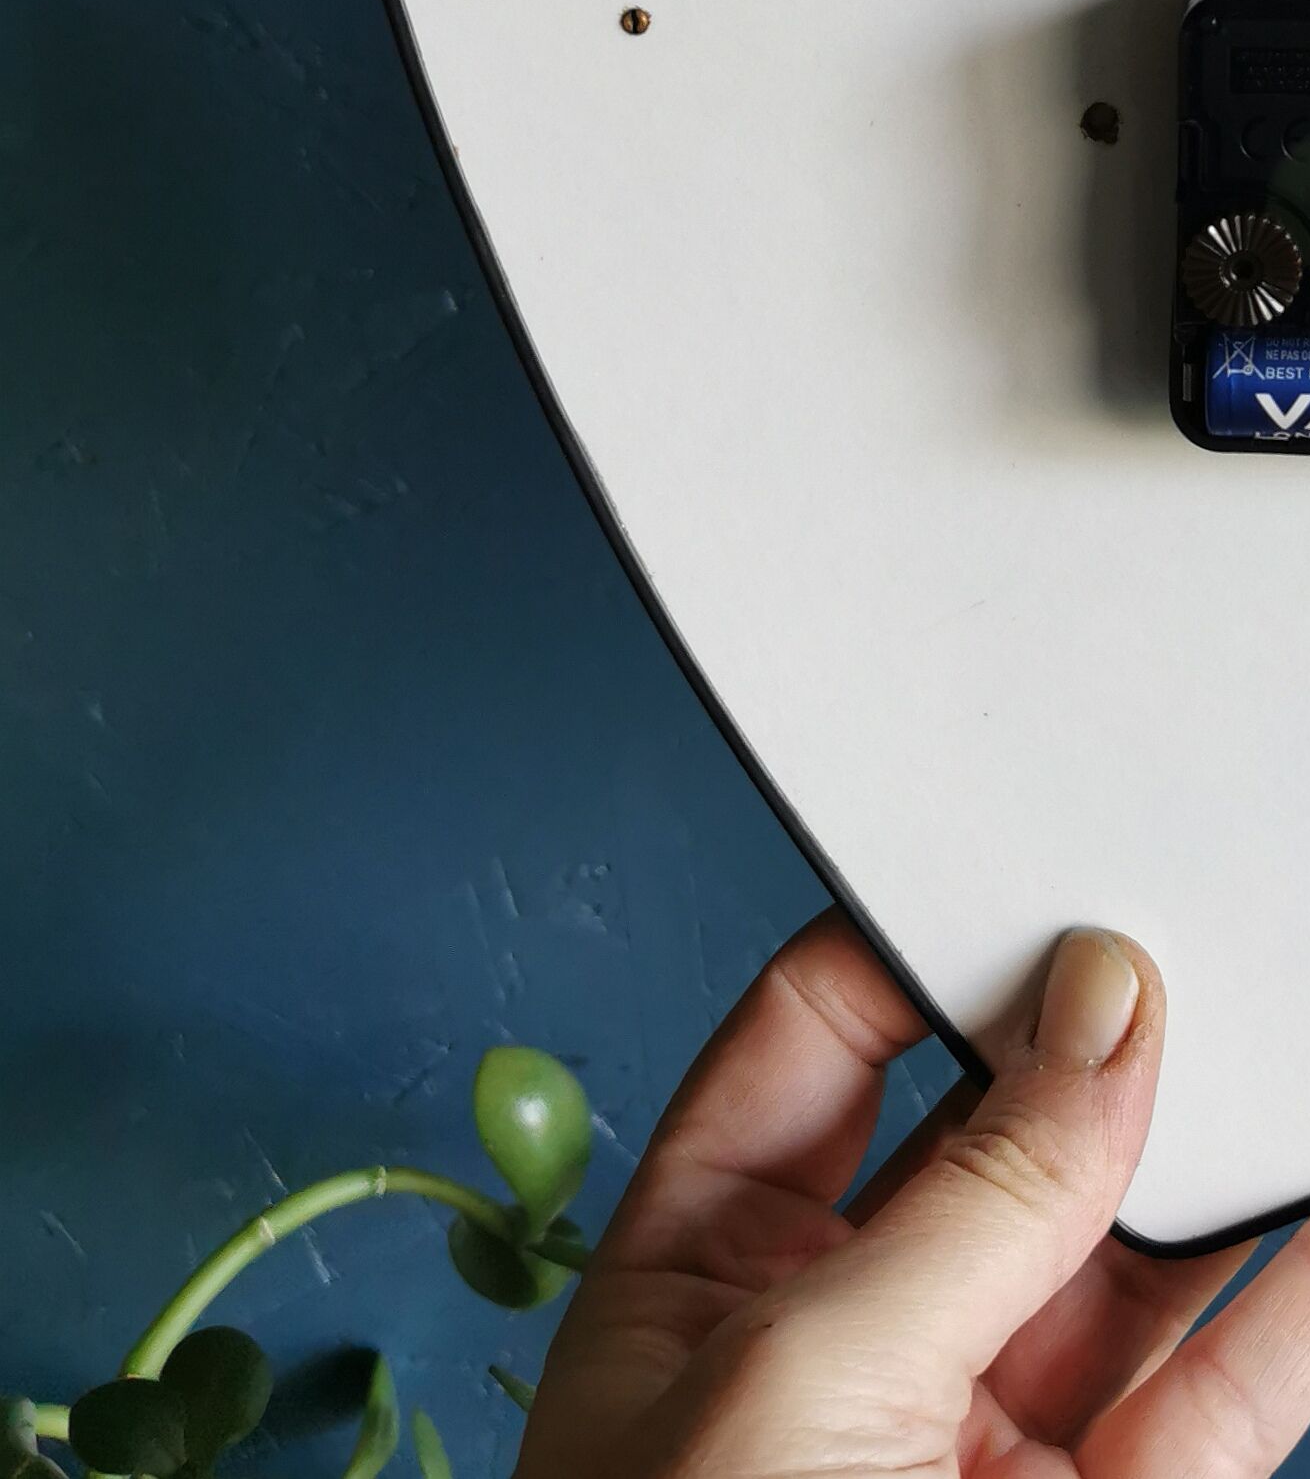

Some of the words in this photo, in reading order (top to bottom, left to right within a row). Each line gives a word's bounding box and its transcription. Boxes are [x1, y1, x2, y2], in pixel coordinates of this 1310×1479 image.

[1265, 349, 1280, 361] NE
[1280, 349, 1300, 361] PAS
[1265, 365, 1304, 380] BEST
